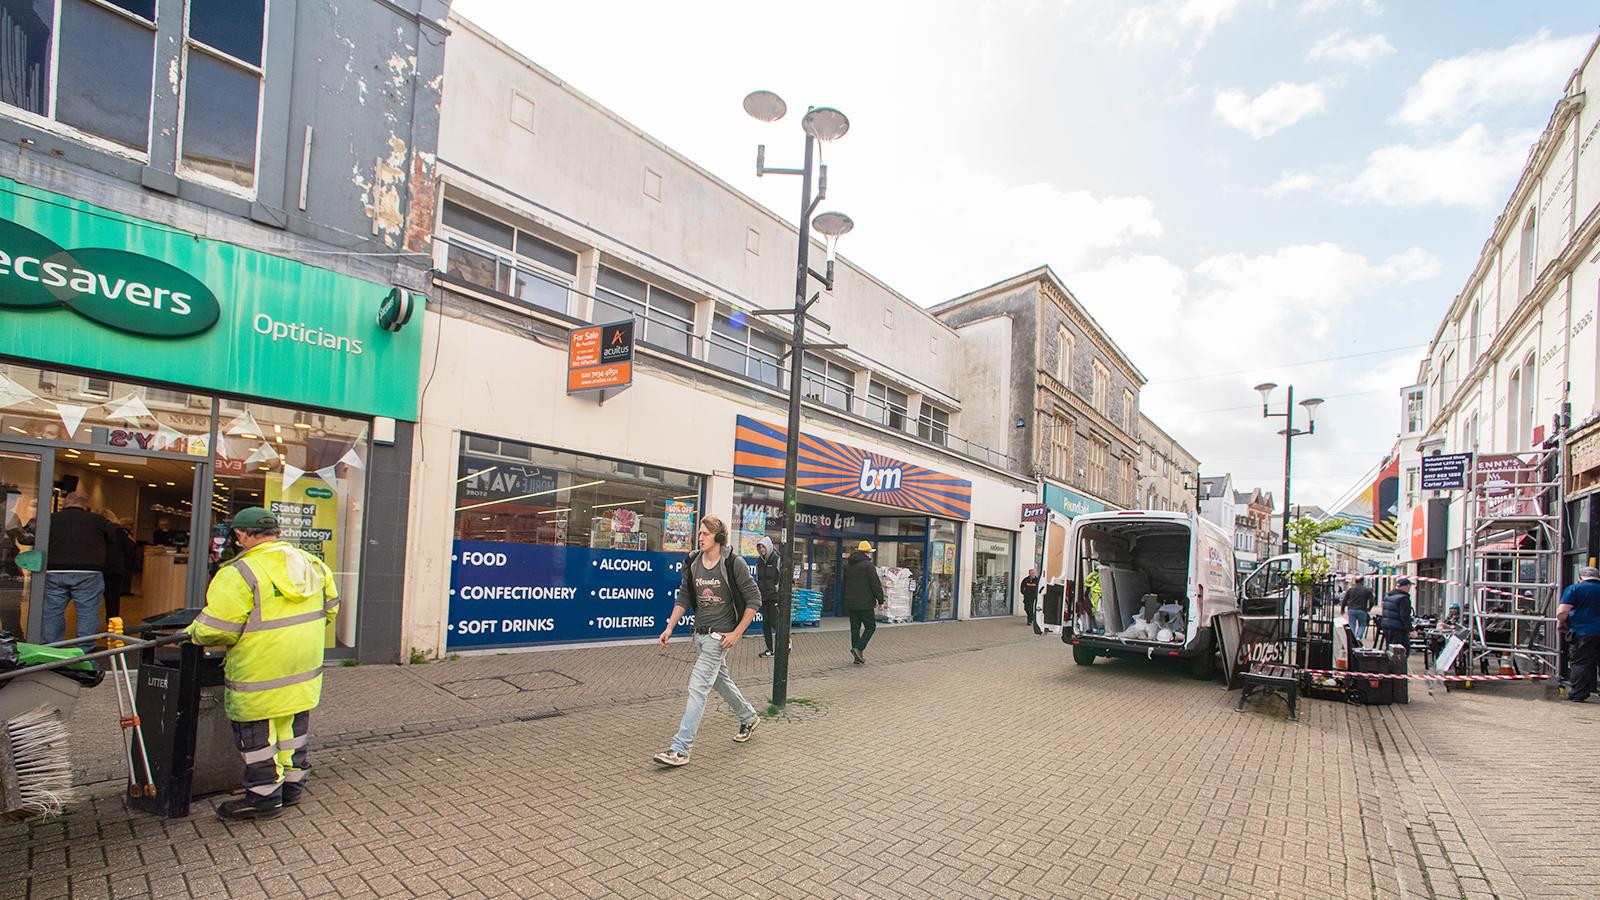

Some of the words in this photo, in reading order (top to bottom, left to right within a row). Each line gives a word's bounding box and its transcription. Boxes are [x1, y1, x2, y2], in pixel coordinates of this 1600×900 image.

[253, 312, 364, 356] Opticians
[573, 334, 583, 342] For
[585, 332, 599, 340] Sale
[604, 346, 629, 356] acuitus
[1478, 459, 1519, 469] ENNY'S
[272, 503, 300, 513] State
[303, 506, 315, 514] of
[276, 514, 291, 524] he
[293, 518, 312, 527] eye
[795, 512, 817, 524] ome
[820, 514, 831, 526] to
[462, 552, 507, 567] FOOD
[600, 558, 653, 572] ALCOHOL
[460, 586, 577, 600] CONFECTIONERY
[598, 588, 654, 600] CLEANING
[458, 620, 498, 634] SOFT
[502, 618, 554, 633] DRINKS
[597, 616, 655, 628] TOILETRIES
[677, 614, 696, 626] OYS
[148, 677, 168, 688] LITTER
